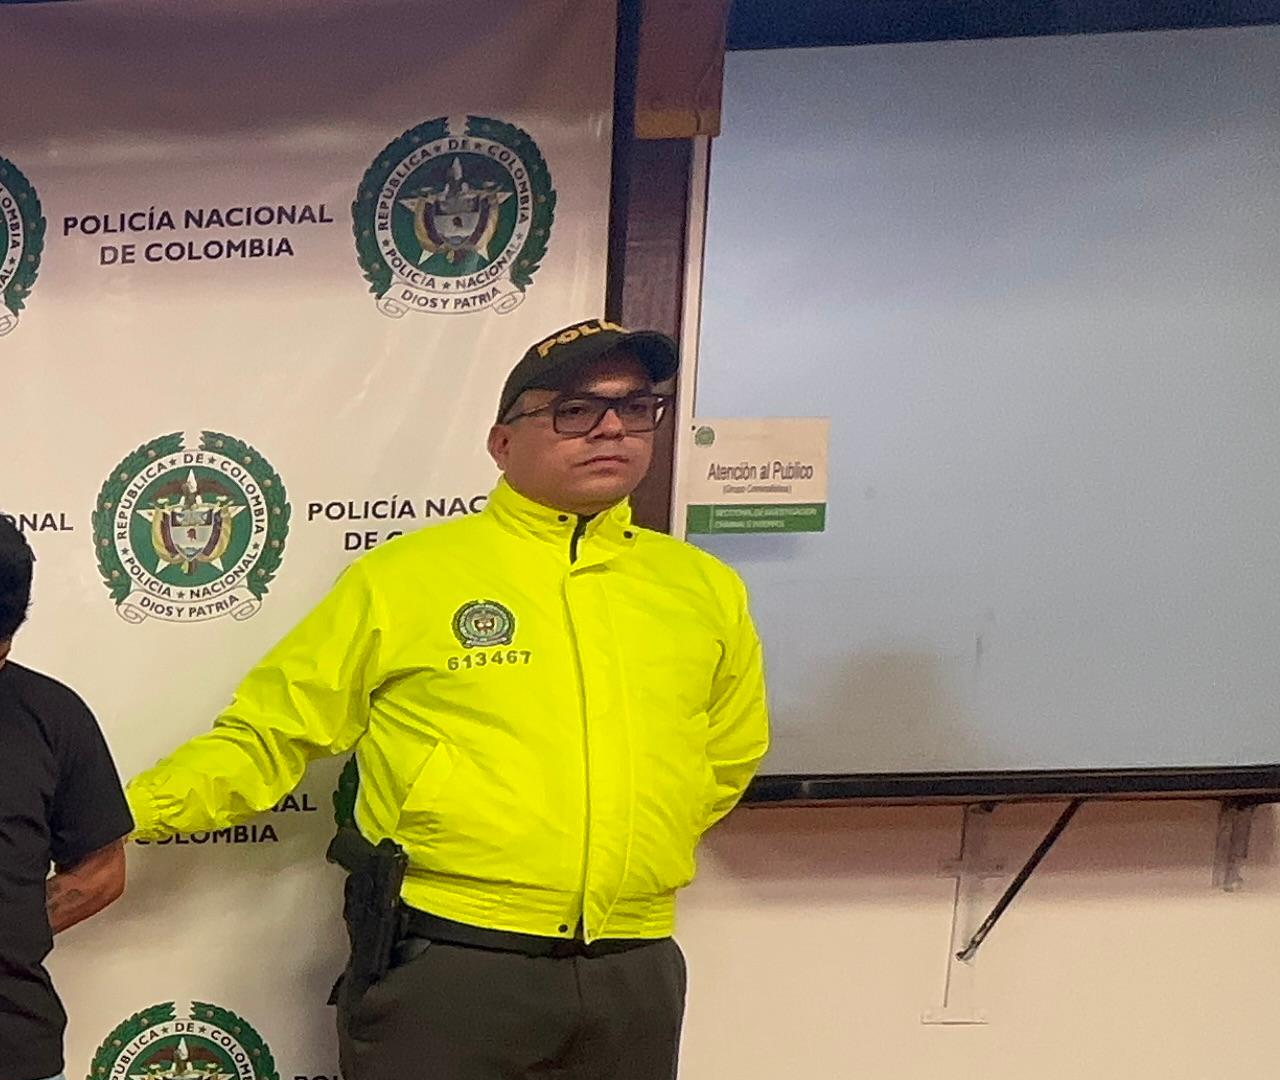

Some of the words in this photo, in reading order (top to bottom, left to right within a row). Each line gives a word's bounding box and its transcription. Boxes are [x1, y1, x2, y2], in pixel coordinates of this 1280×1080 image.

[378, 149, 432, 231] REPUBLICA
[449, 140, 469, 150] DE
[489, 145, 529, 224] COLOMBIA
[63, 207, 175, 236] POLICÍA
[184, 205, 334, 229] NACIONAL
[101, 245, 135, 265] DE
[145, 238, 294, 262] COLOMBIA
[455, 242, 521, 289] NACIONAL
[402, 289, 437, 308] DIOS
[454, 288, 502, 309] PATRIA
[117, 463, 168, 540] REPUBLICA
[184, 454, 203, 463] DE
[221, 461, 264, 534] COLOMBIA
[308, 495, 416, 521] POLICÍA
[344, 532, 378, 550] DE
[190, 552, 258, 599] NACIONAL
[140, 597, 173, 616] DIOS
[189, 594, 239, 617] PATRIA
[175, 1023, 194, 1032] DE
